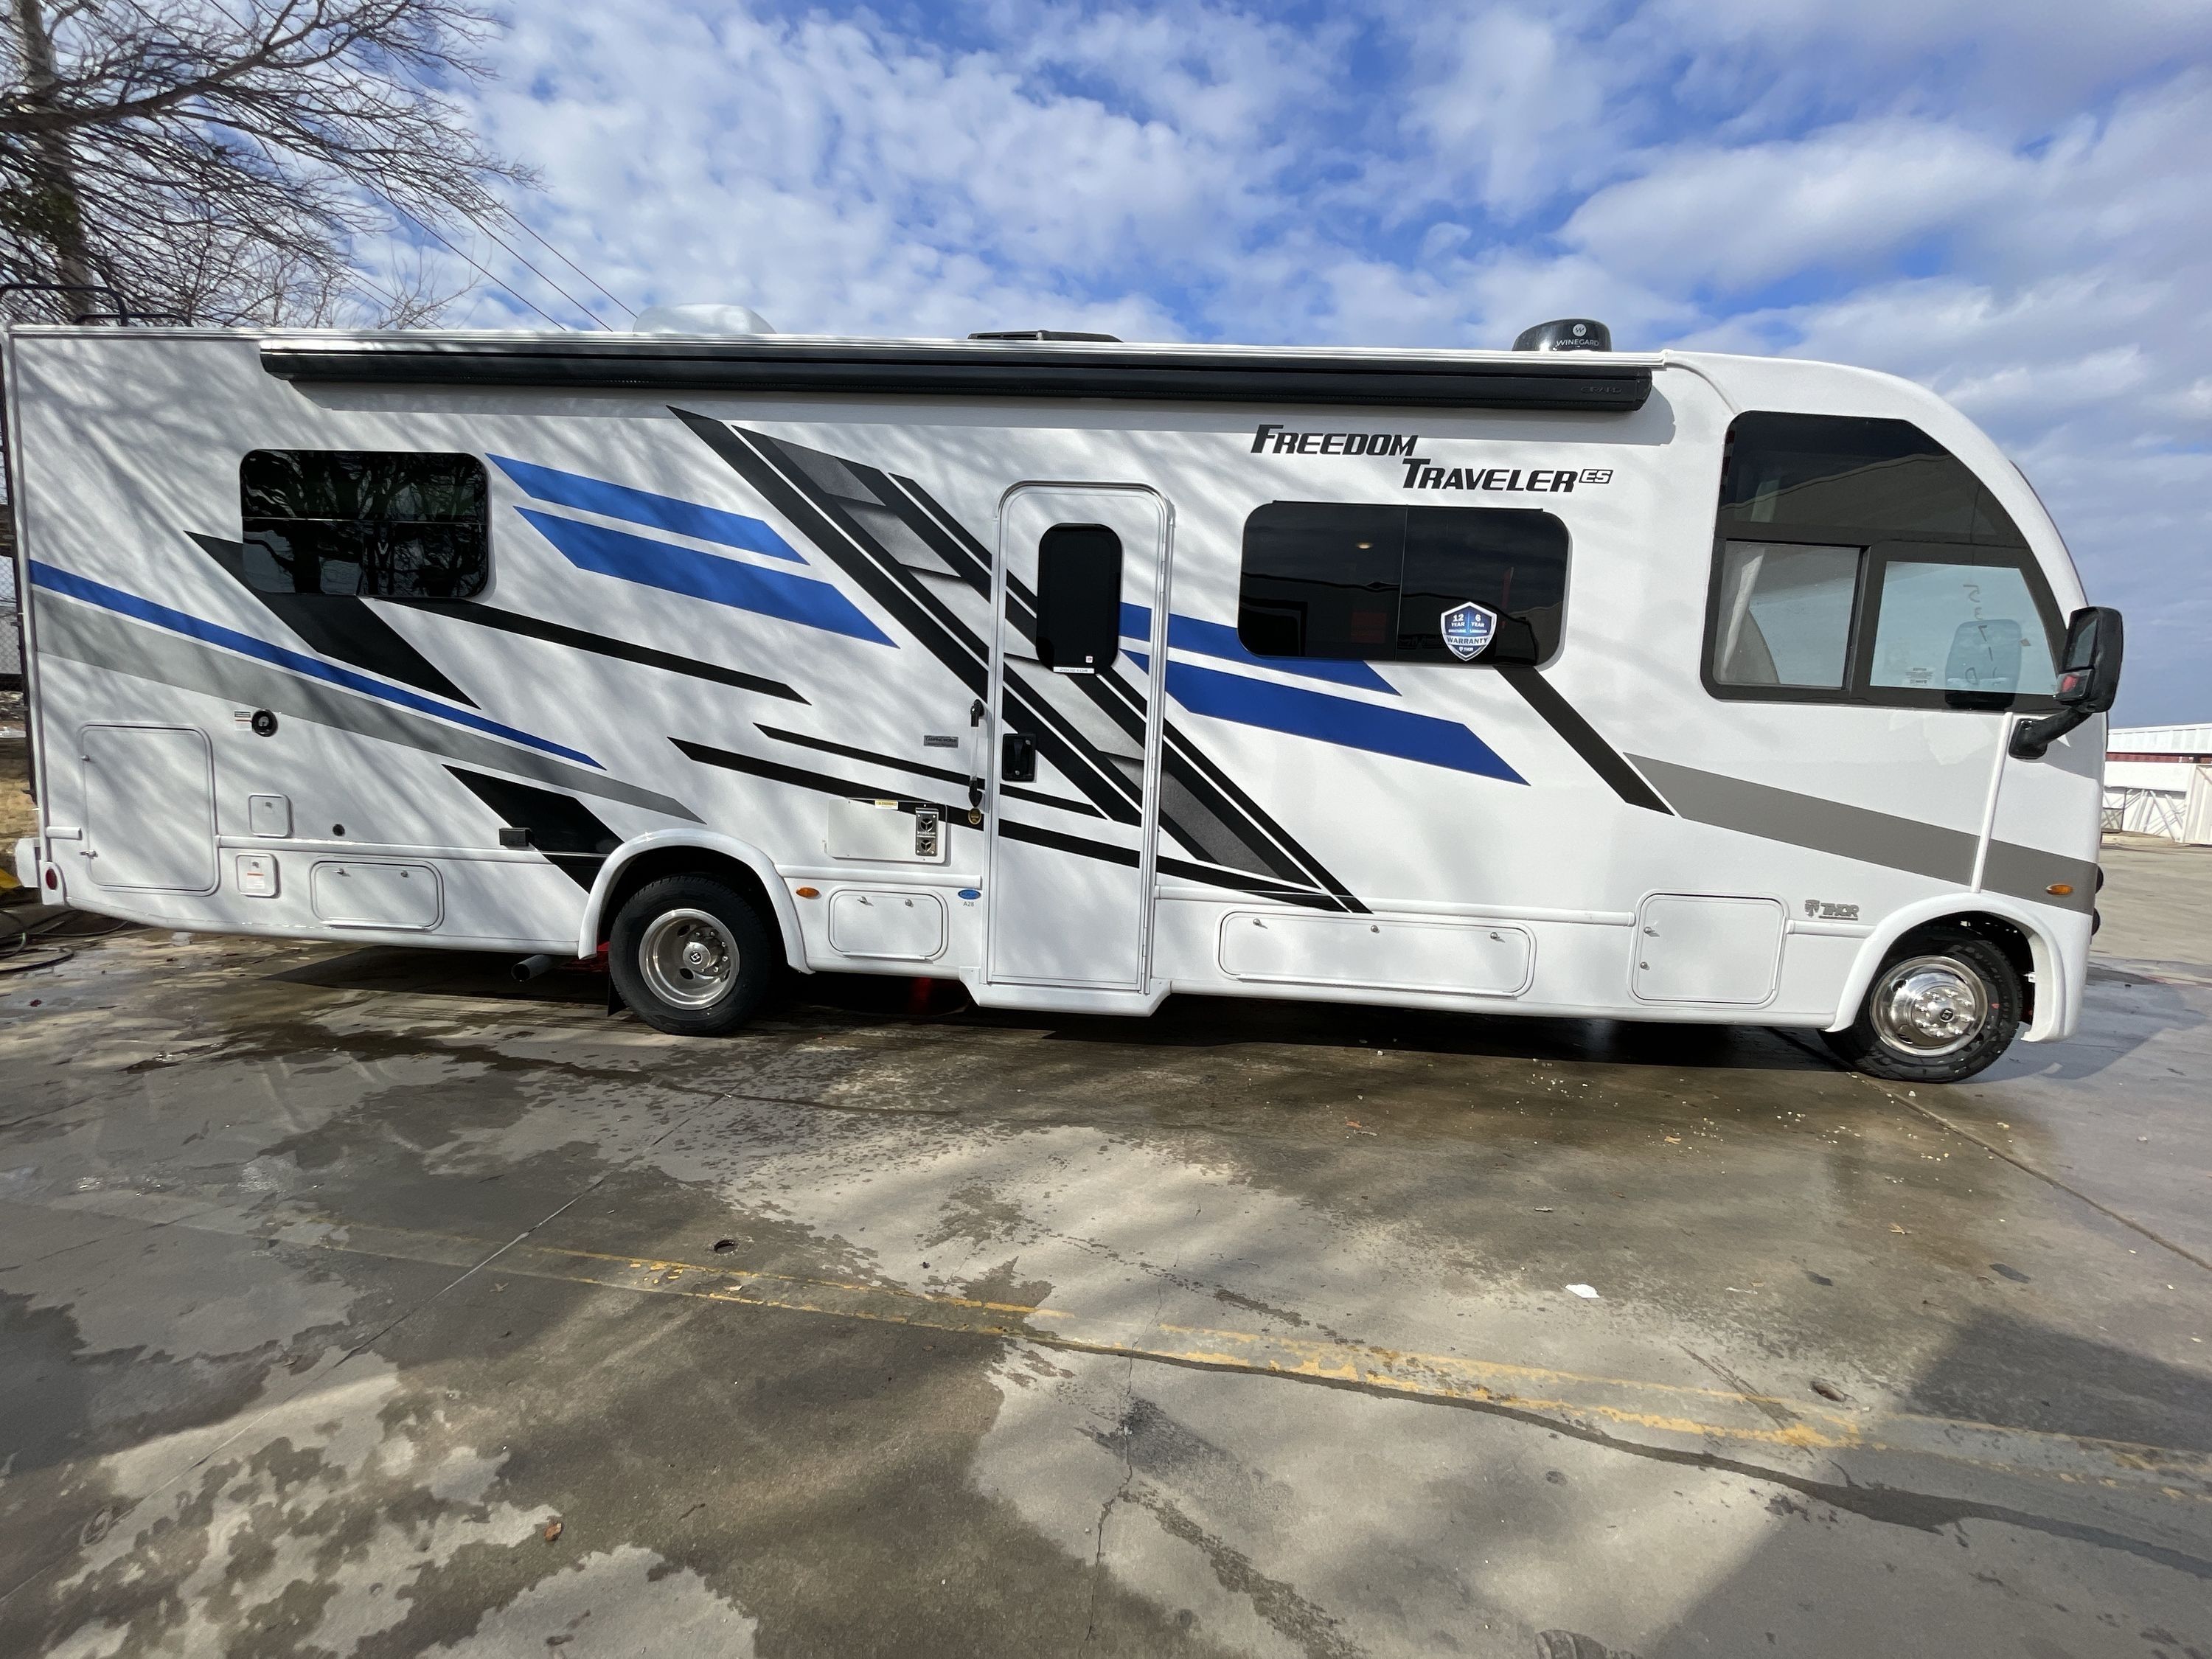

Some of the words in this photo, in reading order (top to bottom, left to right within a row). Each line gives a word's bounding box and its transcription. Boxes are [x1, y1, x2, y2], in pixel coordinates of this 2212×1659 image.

[1555, 338, 1599, 347] WINEGARD
[1251, 424, 1419, 456] FREEDOM
[1402, 458, 1578, 493] TRAVELER
[1580, 469, 1613, 484] ES
[1453, 613, 1464, 622] 12
[1475, 613, 1481, 622] 6
[1447, 636, 1488, 644] WARRANTY
[1820, 902, 1860, 918] THOR
